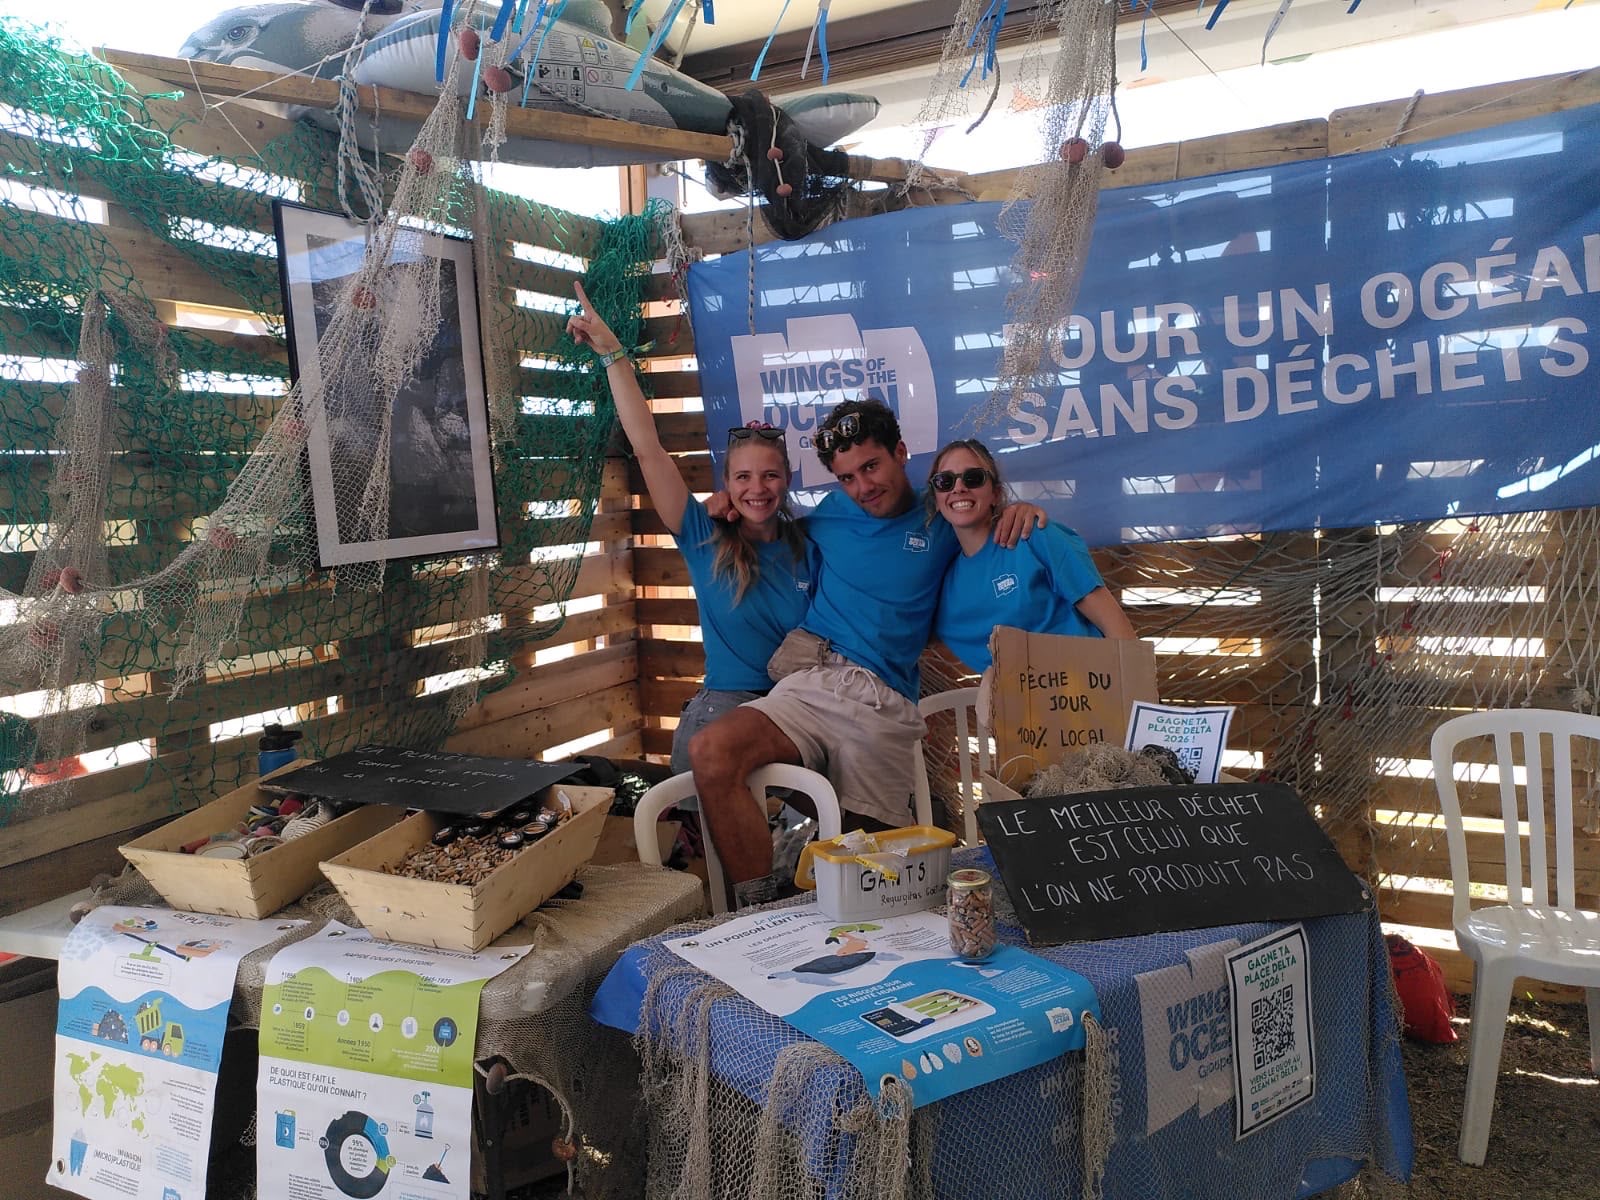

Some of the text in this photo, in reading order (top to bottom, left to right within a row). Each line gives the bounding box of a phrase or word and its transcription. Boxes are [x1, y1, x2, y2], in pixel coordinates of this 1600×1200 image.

[1223, 282, 1334, 348] UN
[760, 358, 865, 394] WINGS
[866, 358, 885, 371] OF
[866, 369, 897, 384] THE
[1007, 317, 1588, 445] SANS DÉCHETS
[763, 384, 900, 431] OCEN
[1019, 665, 1112, 692] PÊCHE DU
[1050, 695, 1092, 712] JOUR
[1147, 723, 1212, 735] PLACE DELTA
[1156, 716, 1208, 726] GAGNE TA
[1017, 726, 1048, 749] 100%
[1163, 735, 1189, 743] 2026
[997, 809, 1036, 837] LE
[1183, 792, 1265, 819] DÉCHET
[1068, 829, 1122, 865] EST
[1200, 822, 1249, 847] QUE
[1021, 880, 1082, 913] L'ON
[1089, 874, 1124, 902] NE
[1254, 853, 1314, 882] PAS
[705, 917, 793, 948] UN POISON LENT
[1244, 955, 1297, 986] PLACE DELTA
[1247, 944, 1290, 971] GAGNE TA
[1259, 977, 1280, 992] 2026
[1167, 985, 1231, 1034] WING
[1169, 1013, 1232, 1071] OCE
[269, 1076, 306, 1090] PLASTIQUE
[307, 1082, 329, 1094] QU'ON
[270, 1066, 337, 1085] DE QUOI EST FAIT LE
